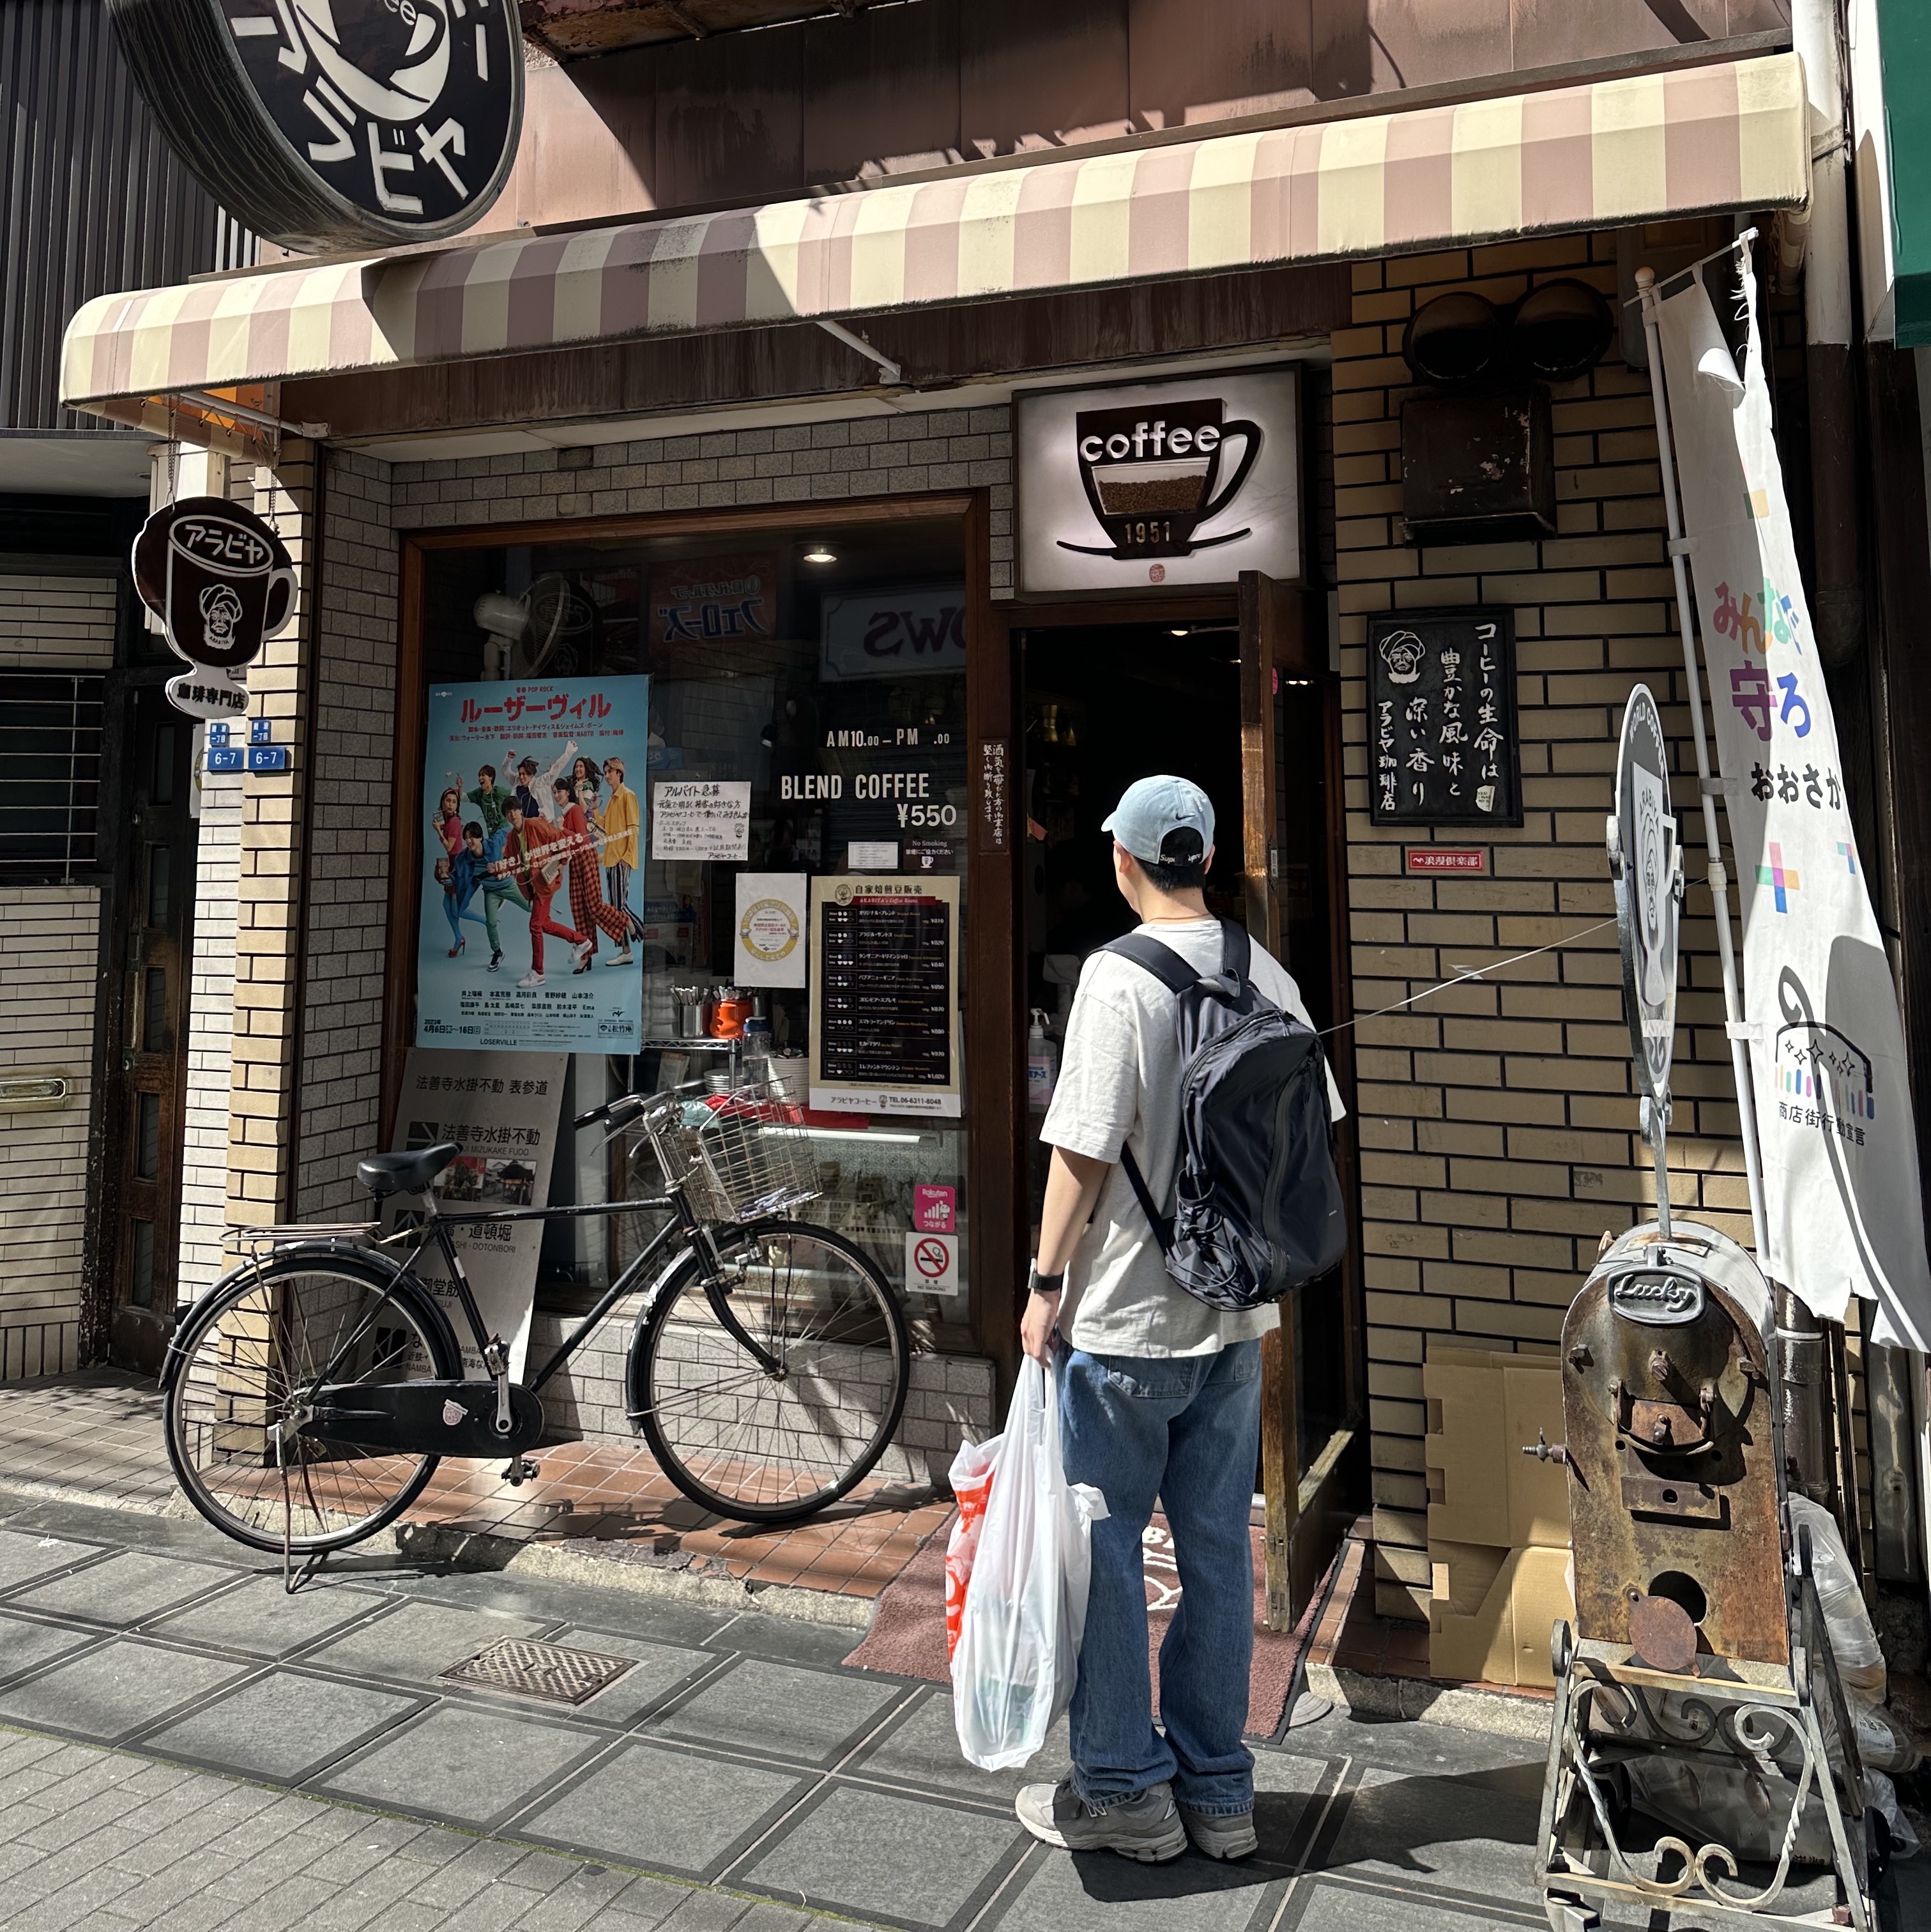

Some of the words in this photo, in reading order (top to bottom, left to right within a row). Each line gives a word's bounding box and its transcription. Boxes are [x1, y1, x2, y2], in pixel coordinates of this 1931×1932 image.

[1080, 420, 1220, 461] coffee
[185, 525, 264, 564] アラビヤ
[1124, 521, 1171, 544] 1951
[177, 682, 246, 710] 珈琲専門店
[461, 693, 612, 723] ルーザーヴィル
[1474, 623, 1504, 780] コーヒーの生命は
[1439, 647, 1469, 796] 豊かな風味と
[896, 728, 919, 746] PM
[215, 752, 236, 765] 6-7
[256, 751, 277, 764] 6-7
[1378, 700, 1398, 811] アラビヤ珈琲店
[1405, 696, 1435, 806] 深い香り
[781, 775, 843, 799] BLEND
[855, 773, 929, 798] COFFEE
[1750, 762, 1842, 811] おおさか
[897, 804, 957, 828] ¥550
[416, 1075, 505, 1094] 法善寺水掛不動
[509, 1079, 549, 1096] 表参道
[830, 1096, 878, 1105] アラビヤコーヒー
[441, 1123, 541, 1146] 法善寺水掛不動
[1779, 1101, 1866, 1147] 商店街行動宣言
[471, 1146, 507, 1155] MIZUKAKE
[508, 1147, 530, 1156] FUDO
[922, 1188, 948, 1197] Rakuten
[473, 1242, 516, 1254] DOTONBORI
[1614, 1273, 1696, 1312] Lucky
